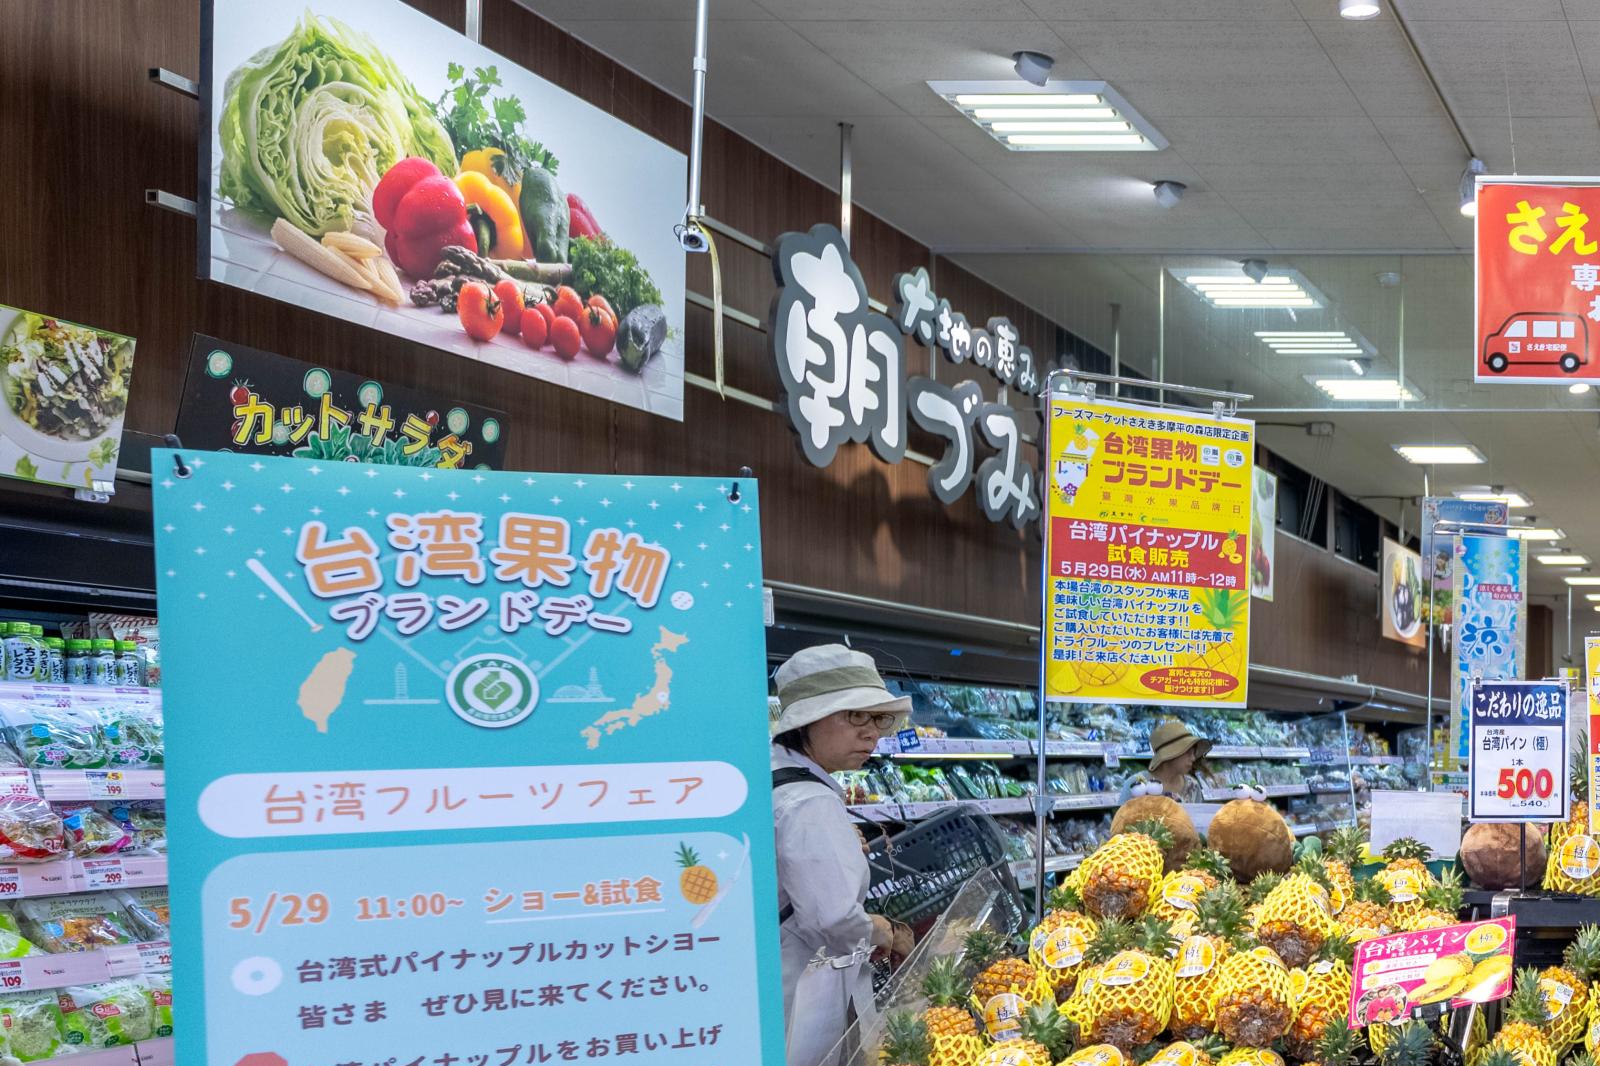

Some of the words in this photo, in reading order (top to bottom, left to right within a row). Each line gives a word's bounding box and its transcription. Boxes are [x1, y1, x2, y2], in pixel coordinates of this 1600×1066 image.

[900, 270, 1037, 395] 大地の恵み
[232, 392, 472, 470] カットサラダ
[1104, 432, 1197, 463] 台湾果物
[1103, 460, 1242, 493] ブランドデー
[1069, 521, 1219, 550] 台湾パイナップル
[297, 511, 670, 608] 台湾果物
[1107, 544, 1190, 568] 試食販売
[1055, 580, 1190, 600] 本場台湾のスタッフが来店
[331, 593, 632, 640] ブランドデー
[473, 660, 513, 670] TAP
[1475, 691, 1562, 720] こだわりの逸品
[1511, 758, 1524, 766] 1本
[1497, 768, 1554, 799] 500
[263, 776, 704, 825] 台湾フルーツフェア
[228, 891, 330, 934] 5/29
[485, 876, 663, 913] ショー&試食
[296, 931, 720, 984] 台湾式パイナップルカットショー
[1364, 930, 1470, 959] 台湾パイン
[2, 976, 22, 987] 109
[298, 999, 388, 1030] 皆さま
[421, 974, 710, 1018] ぜひ見に来てください。
